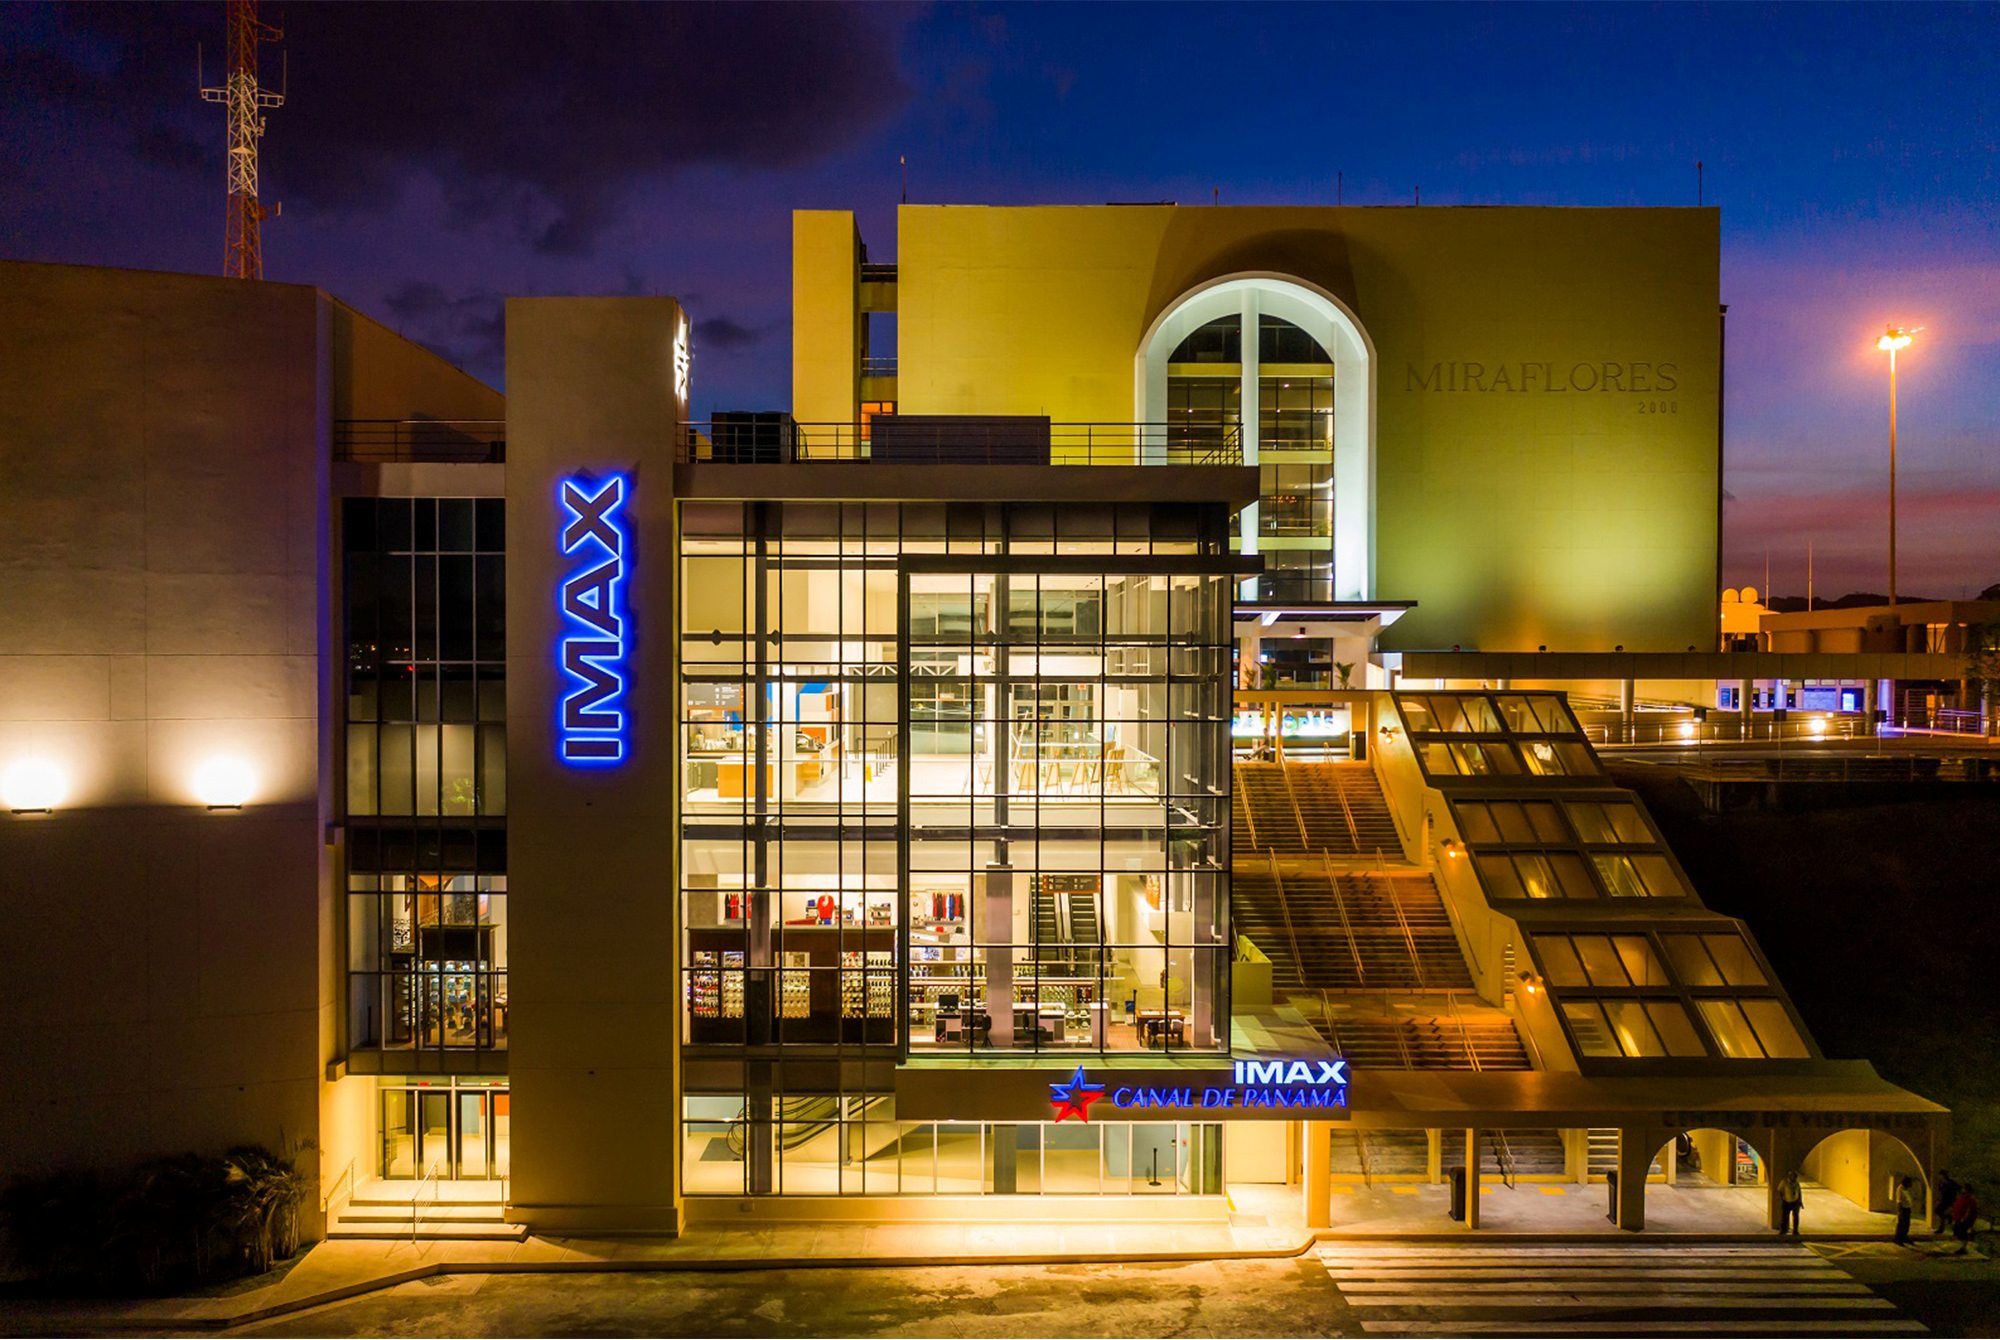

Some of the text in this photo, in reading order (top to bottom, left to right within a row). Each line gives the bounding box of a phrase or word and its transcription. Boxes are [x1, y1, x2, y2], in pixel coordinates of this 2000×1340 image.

[1404, 361, 1679, 393] MIRAFLORES
[1638, 401, 1678, 415] 2000
[562, 476, 623, 761] IMAX
[1233, 1061, 1348, 1084] IMAX
[1111, 1084, 1348, 1108] CANAL DE PANAMÁ
